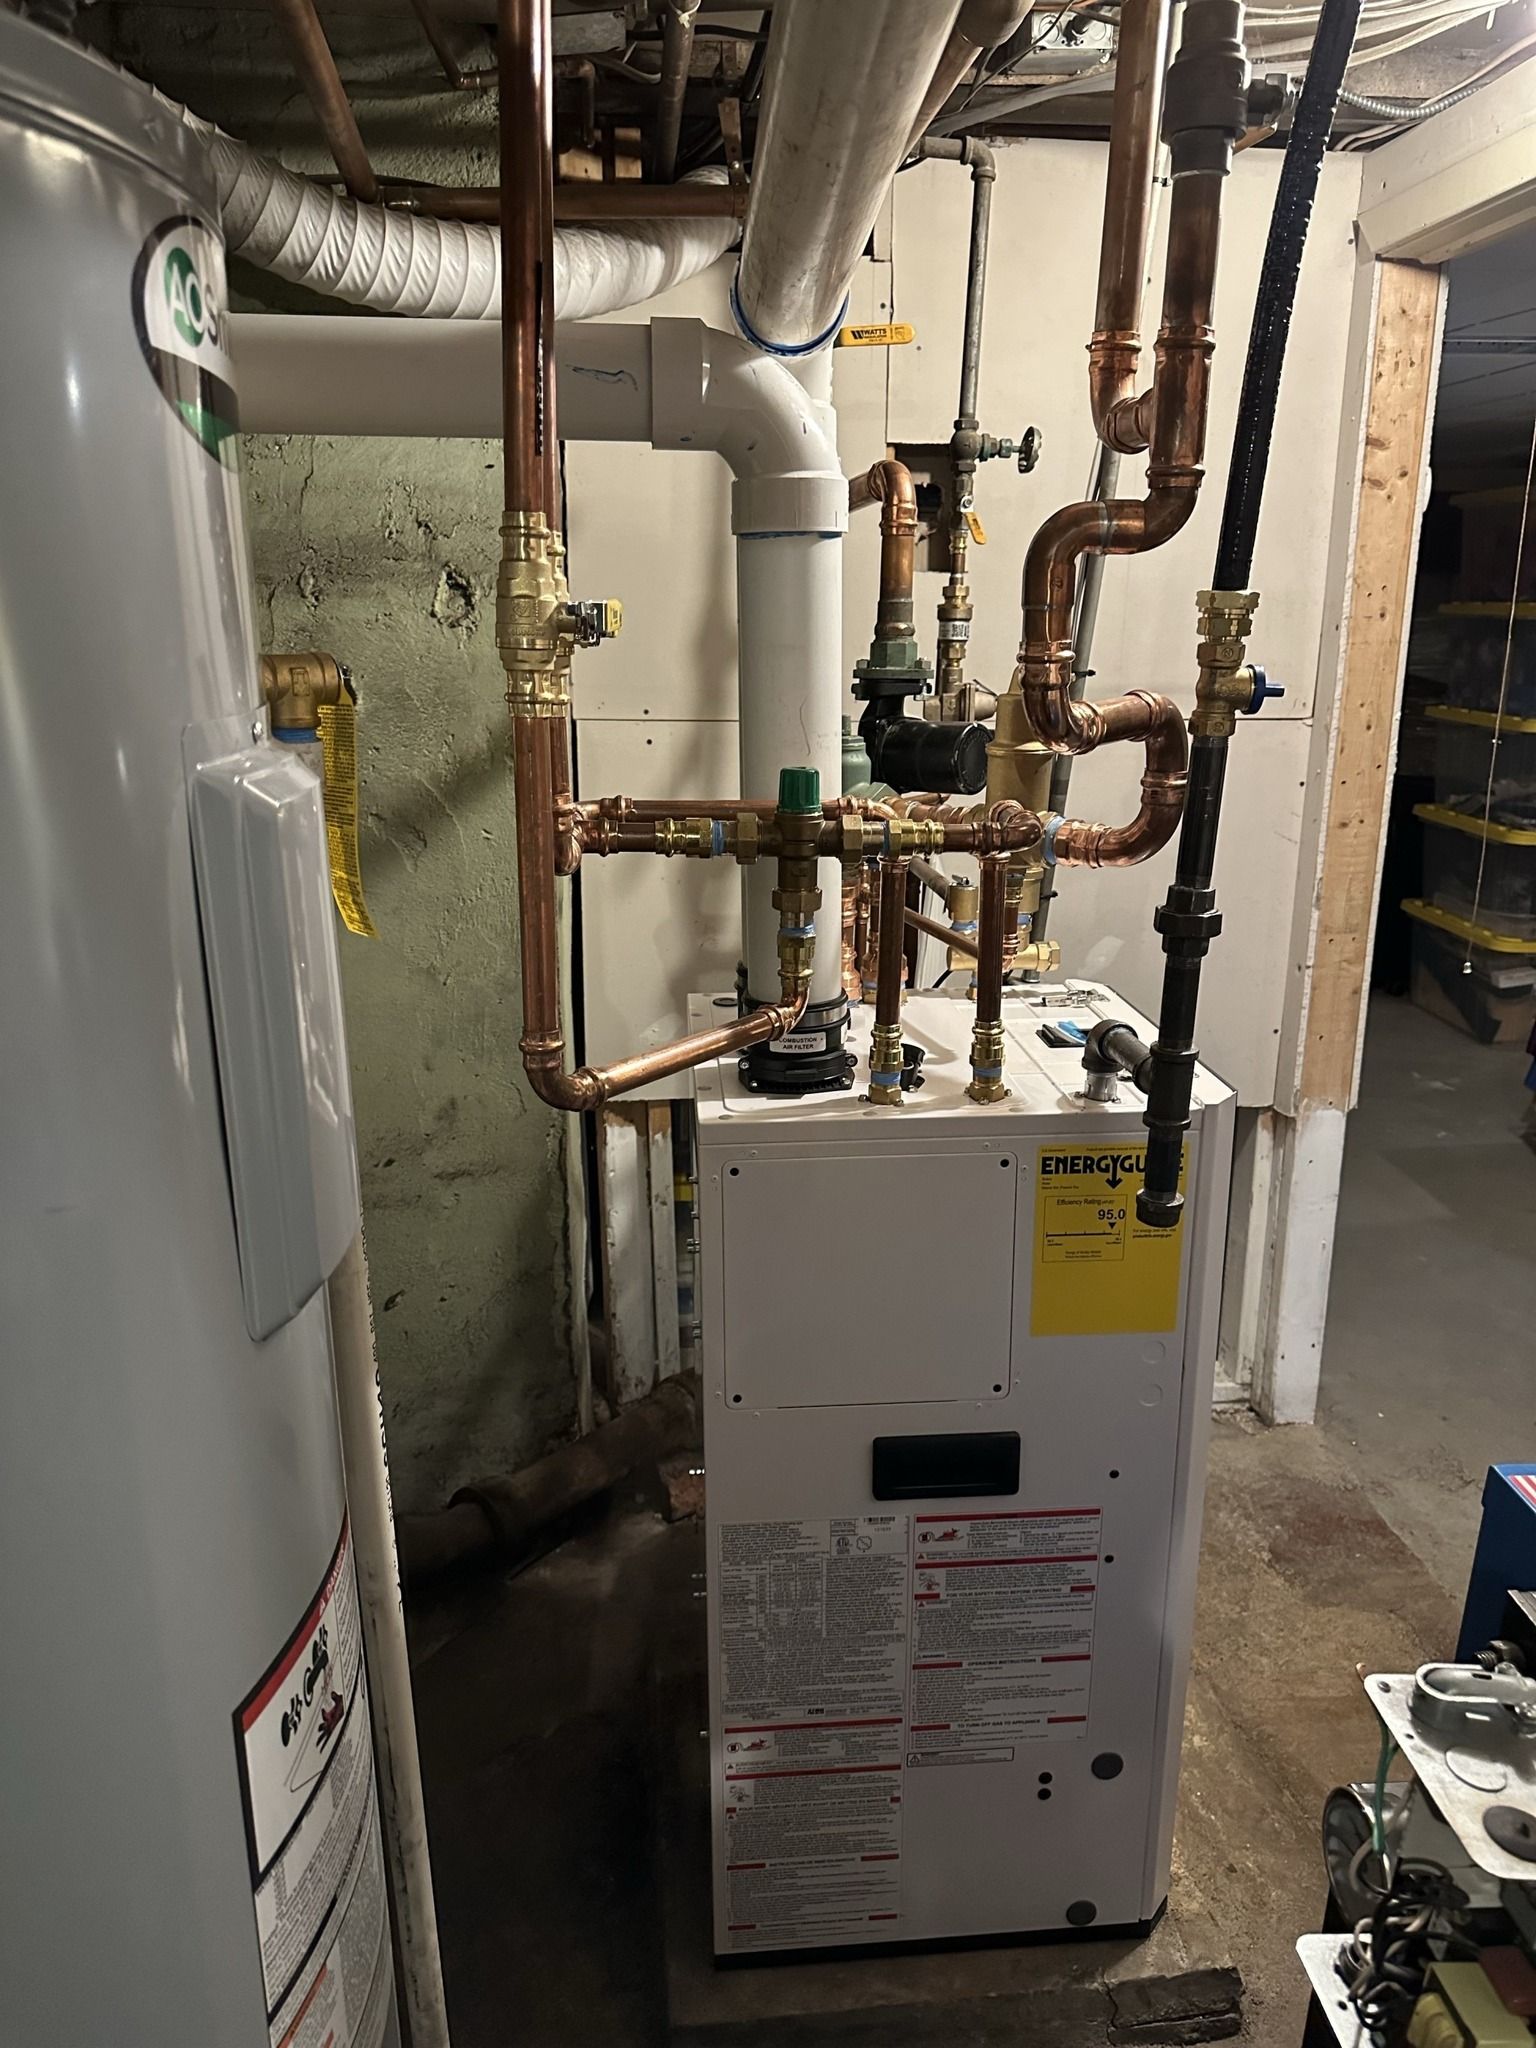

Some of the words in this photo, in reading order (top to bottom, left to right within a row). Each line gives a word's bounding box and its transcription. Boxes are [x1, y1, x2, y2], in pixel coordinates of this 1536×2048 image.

[1041, 1154, 1184, 1175] ENERGYGU
[1056, 1199, 1082, 1207] Efficiency
[1084, 1198, 1102, 1206] Rating
[1098, 1209, 1126, 1220] 95.0
